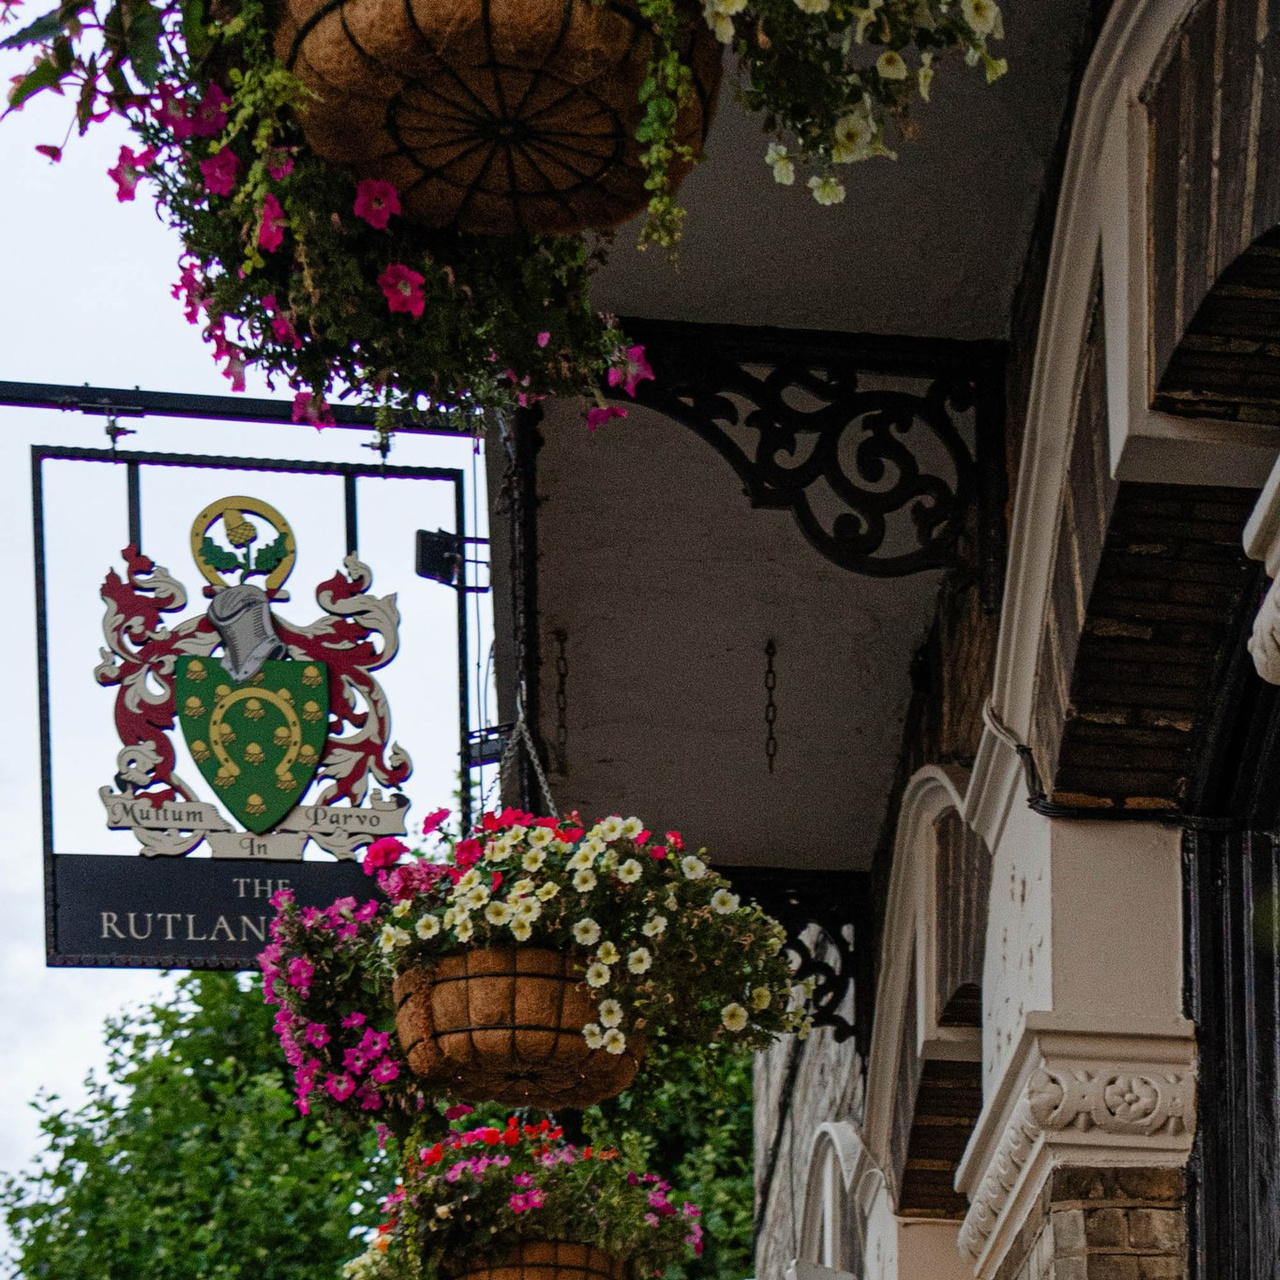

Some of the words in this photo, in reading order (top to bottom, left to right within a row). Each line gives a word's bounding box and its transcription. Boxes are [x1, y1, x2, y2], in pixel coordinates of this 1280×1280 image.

[305, 806, 381, 828] Parvo
[239, 837, 268, 856] In
[100, 911, 276, 942] RUTLAN
